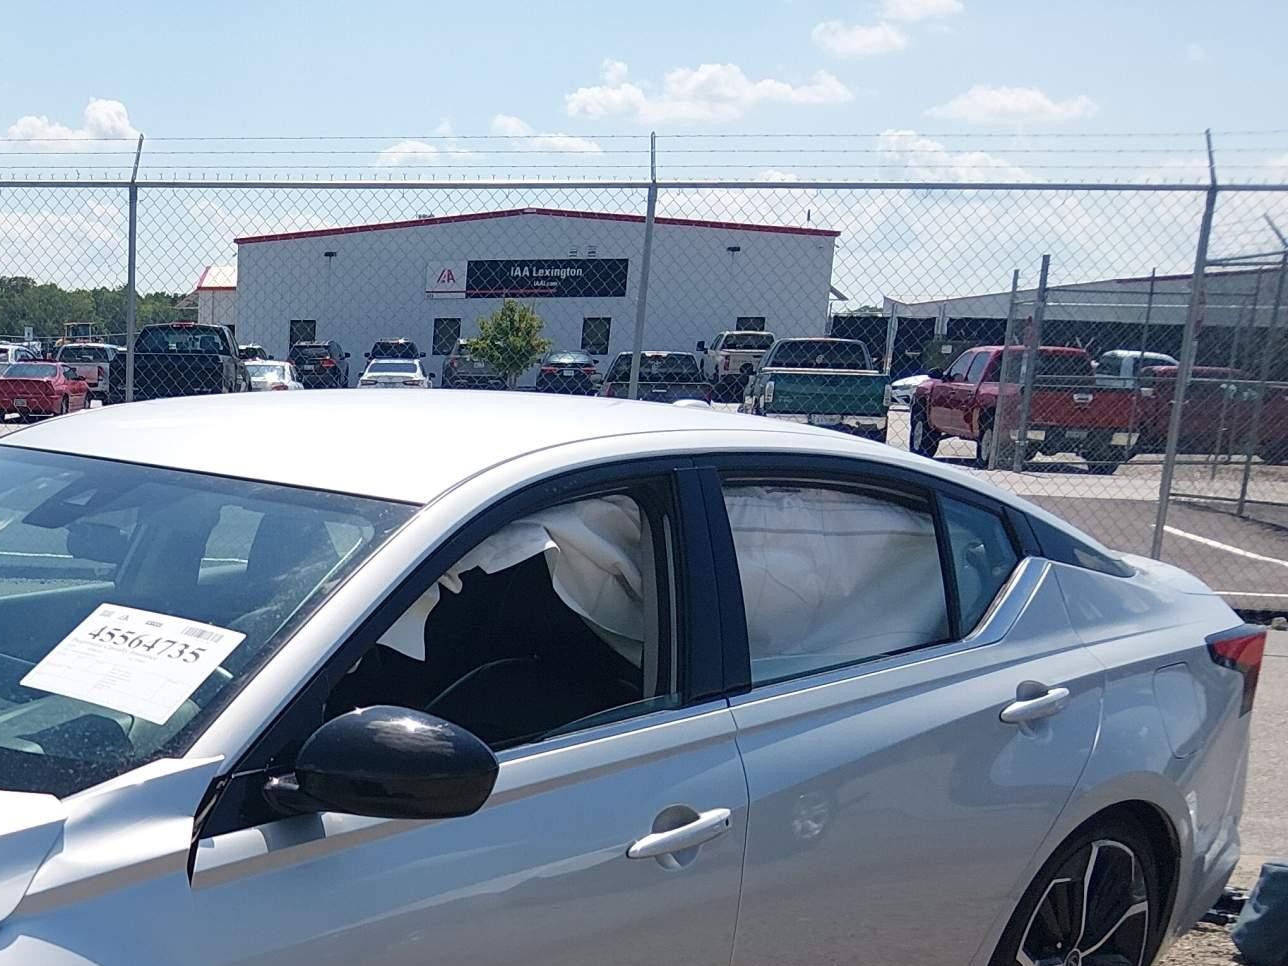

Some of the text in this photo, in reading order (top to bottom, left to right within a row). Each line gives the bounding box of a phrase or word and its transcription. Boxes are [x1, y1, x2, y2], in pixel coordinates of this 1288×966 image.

[510, 266, 583, 279] IAA Lexington
[88, 625, 207, 663] 45564735
